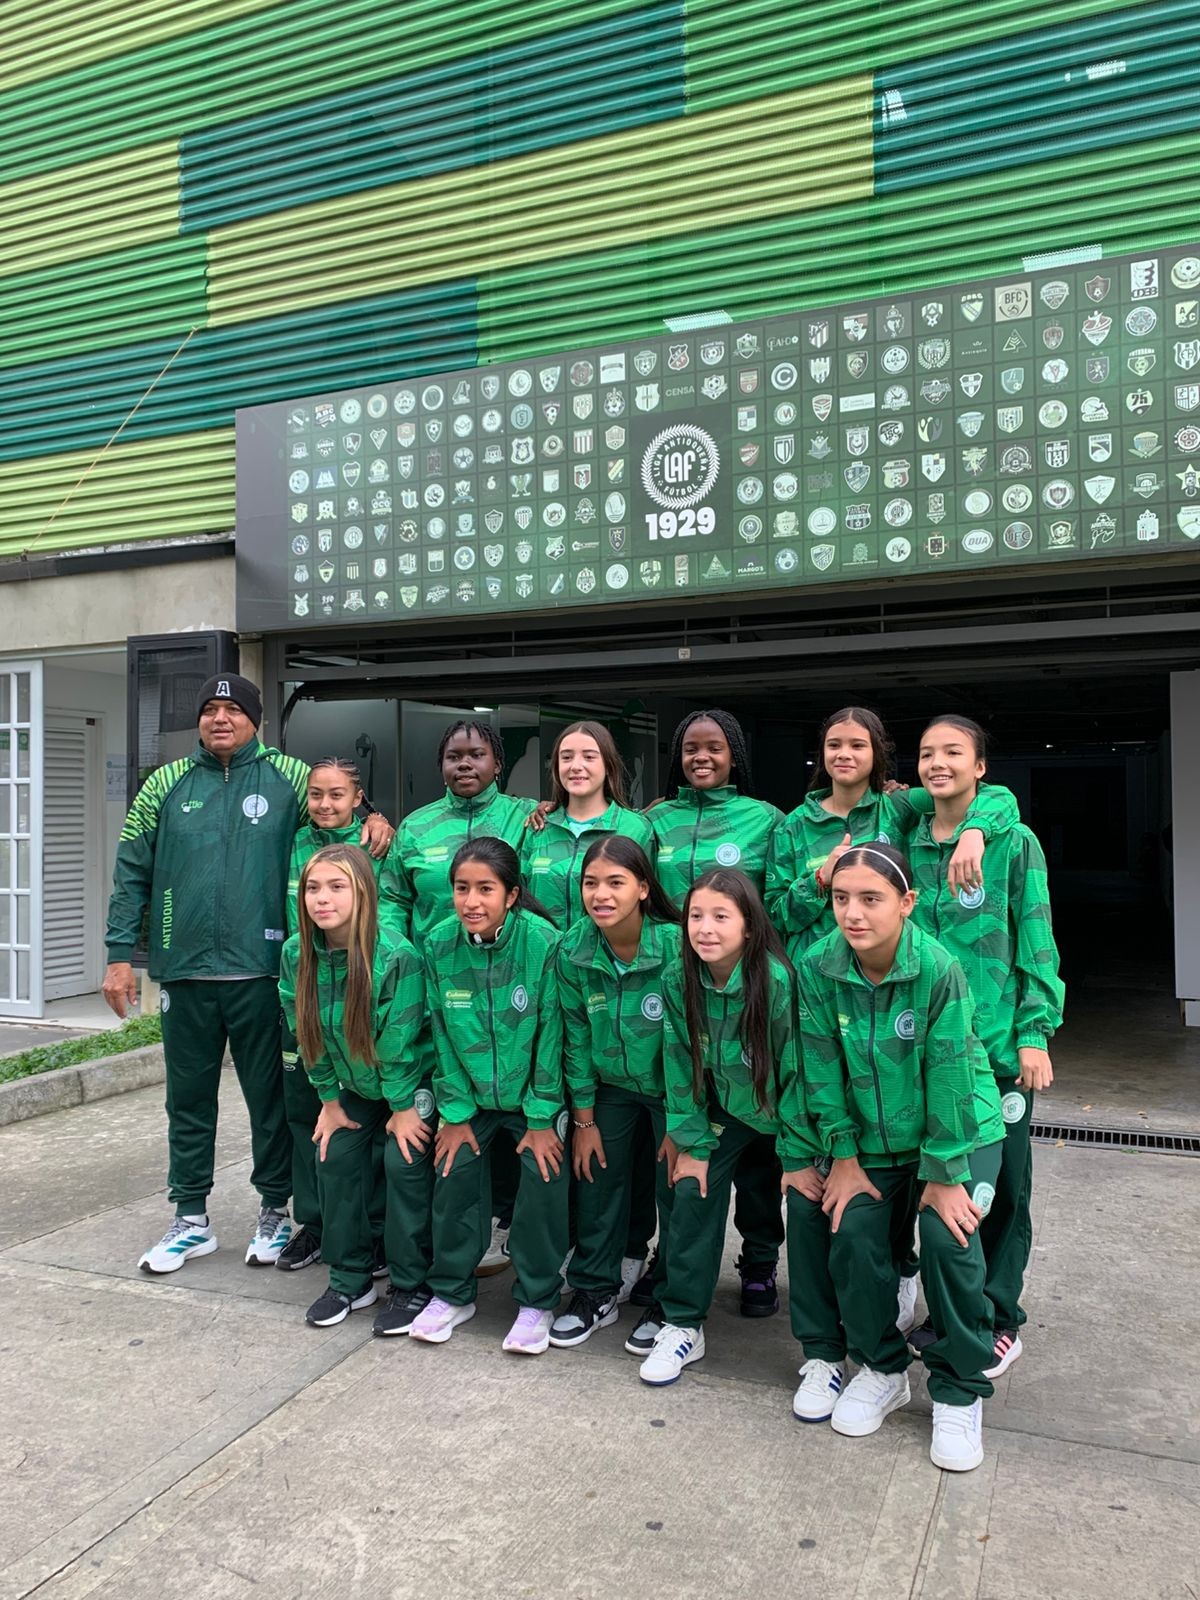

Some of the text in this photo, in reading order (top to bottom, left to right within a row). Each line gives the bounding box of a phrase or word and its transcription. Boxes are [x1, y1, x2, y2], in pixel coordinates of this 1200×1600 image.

[1004, 291, 1023, 305] BFC
[777, 367, 792, 385] C
[665, 385, 695, 398] CENSA
[664, 437, 709, 472] ANTIOQUEÑA
[653, 453, 664, 478] LIGA
[664, 450, 696, 484] LAF
[664, 481, 699, 497] FÚTBOL
[645, 506, 716, 541] 1929
[215, 680, 231, 697] A
[162, 888, 173, 950] ANTIOQUIA
